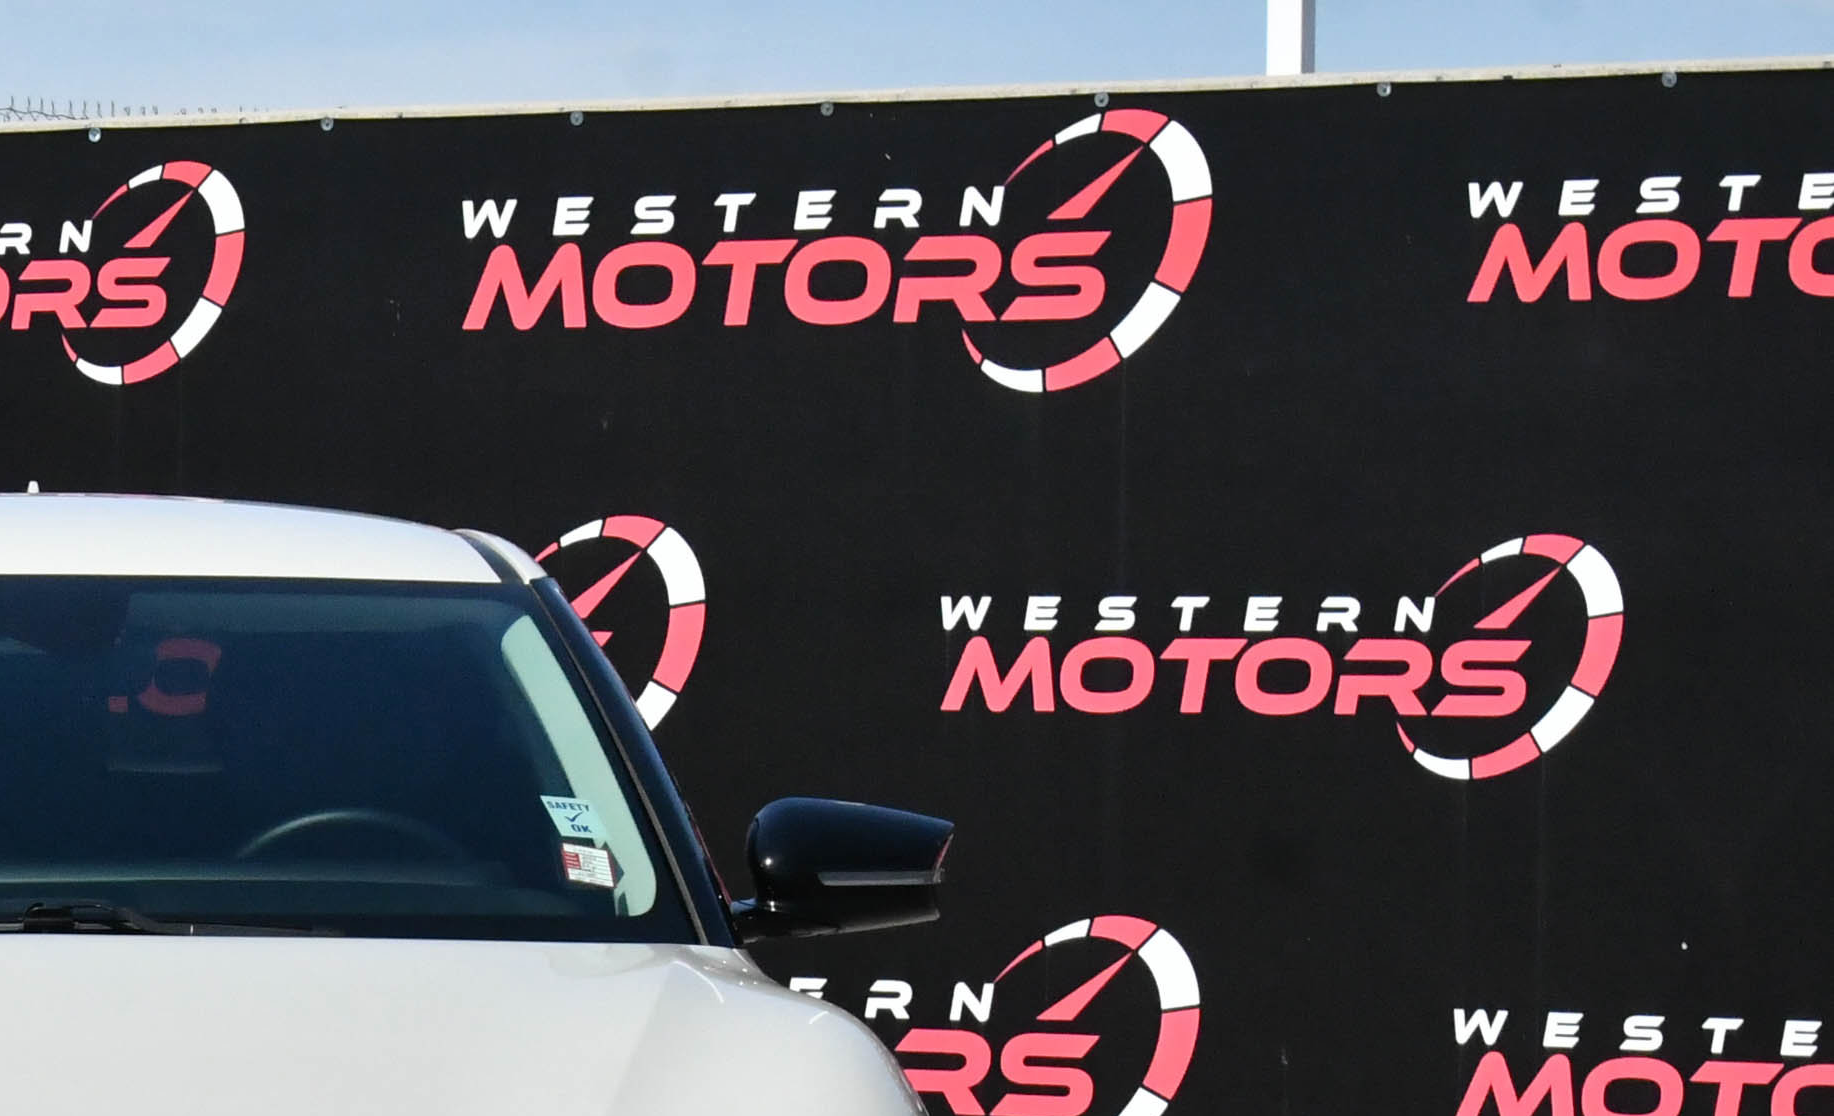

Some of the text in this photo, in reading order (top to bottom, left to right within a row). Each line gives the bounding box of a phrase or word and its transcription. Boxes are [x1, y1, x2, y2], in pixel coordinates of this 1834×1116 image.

[461, 185, 1006, 240] WESTERN
[1467, 172, 1834, 219] WESTE
[461, 229, 1113, 332] MOTORS
[940, 595, 1436, 633] WESTERN
[939, 634, 1533, 719] MOTORS
[546, 800, 590, 812] SAFETY
[1453, 1007, 1823, 1058] WESTE
